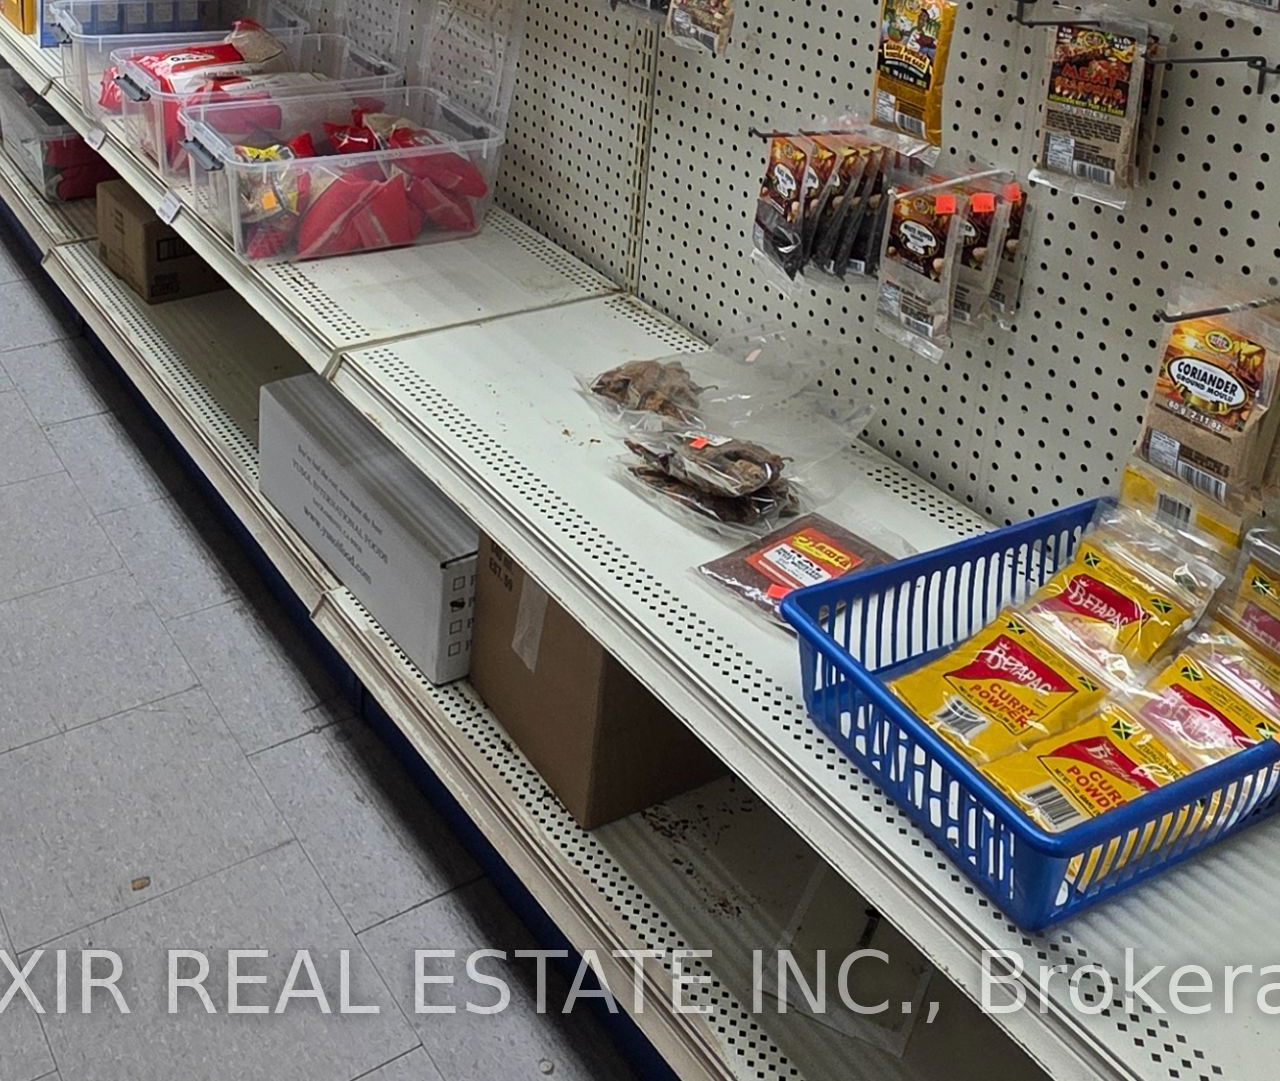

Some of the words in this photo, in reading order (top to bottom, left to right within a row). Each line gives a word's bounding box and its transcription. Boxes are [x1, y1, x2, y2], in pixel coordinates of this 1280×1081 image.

[1176, 373, 1205, 393] GROUND
[1206, 385, 1233, 403] MOULU
[1177, 360, 1238, 397] CORIANDER
[985, 645, 1054, 695] BETAPAC
[970, 684, 1028, 729] POWDER
[989, 683, 1037, 717] CURRY
[1067, 765, 1112, 809] POWD
